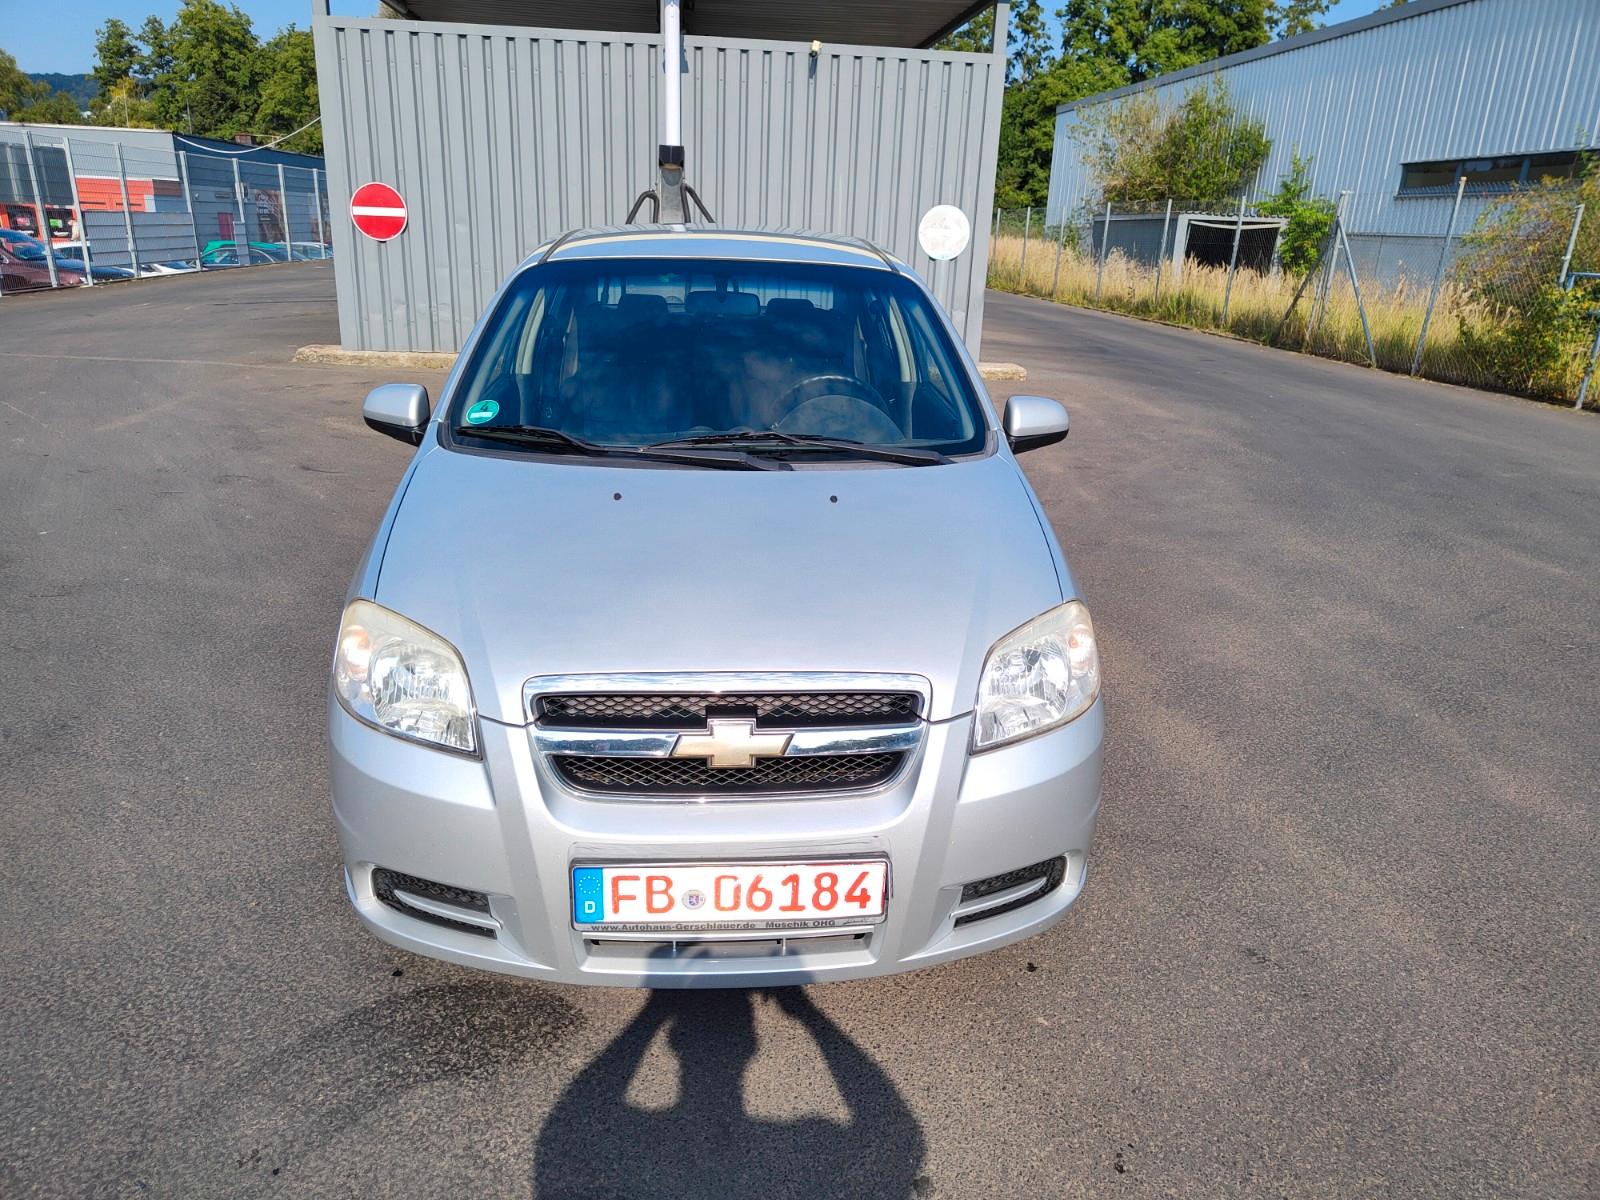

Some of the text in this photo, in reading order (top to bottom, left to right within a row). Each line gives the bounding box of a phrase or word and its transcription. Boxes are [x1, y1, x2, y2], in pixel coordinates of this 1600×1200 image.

[480, 401, 489, 412] 4
[611, 871, 871, 914] FB 06184
[584, 900, 596, 914] D
[591, 922, 756, 931] www.Autohaus-Gerschlauer.de
[765, 920, 808, 929] Muschik
[812, 919, 836, 928] OHG
